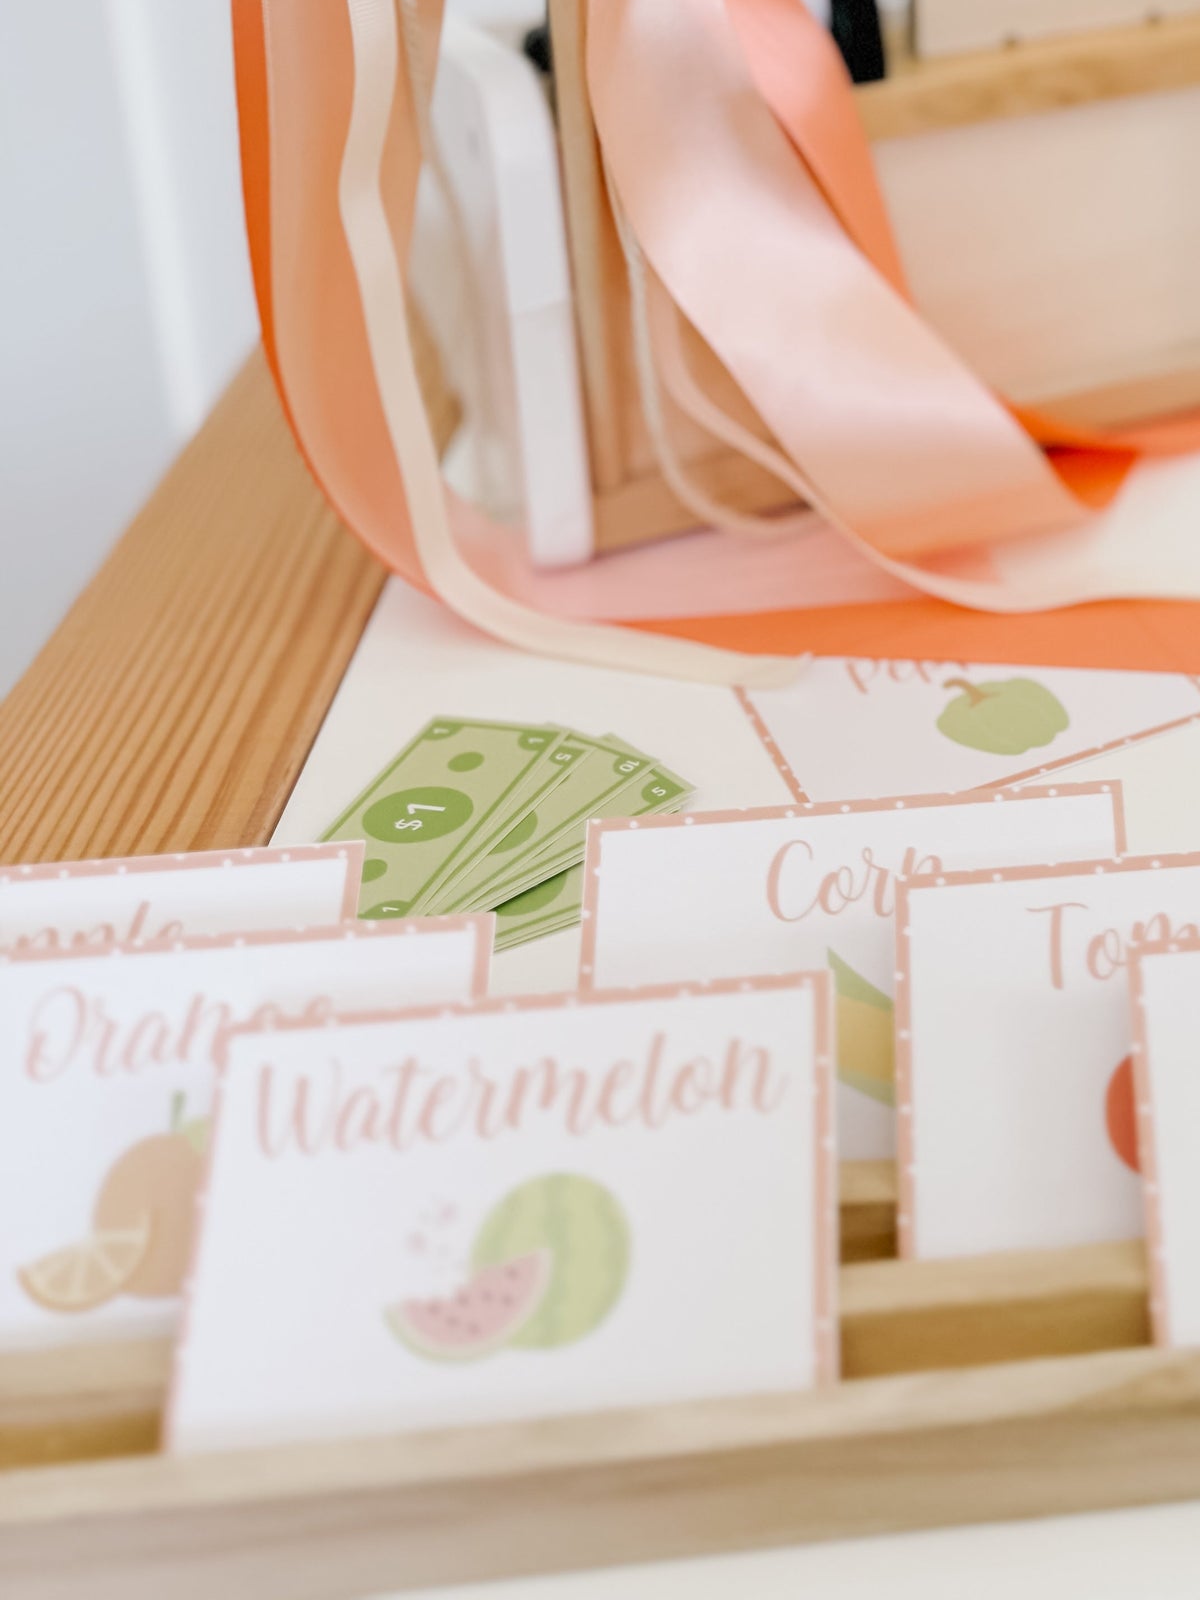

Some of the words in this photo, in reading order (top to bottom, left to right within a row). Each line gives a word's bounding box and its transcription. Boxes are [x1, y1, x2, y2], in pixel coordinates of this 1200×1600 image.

[394, 801, 447, 832] $1
[25, 984, 336, 1085] Oran
[254, 1030, 786, 1160] Watermelon
